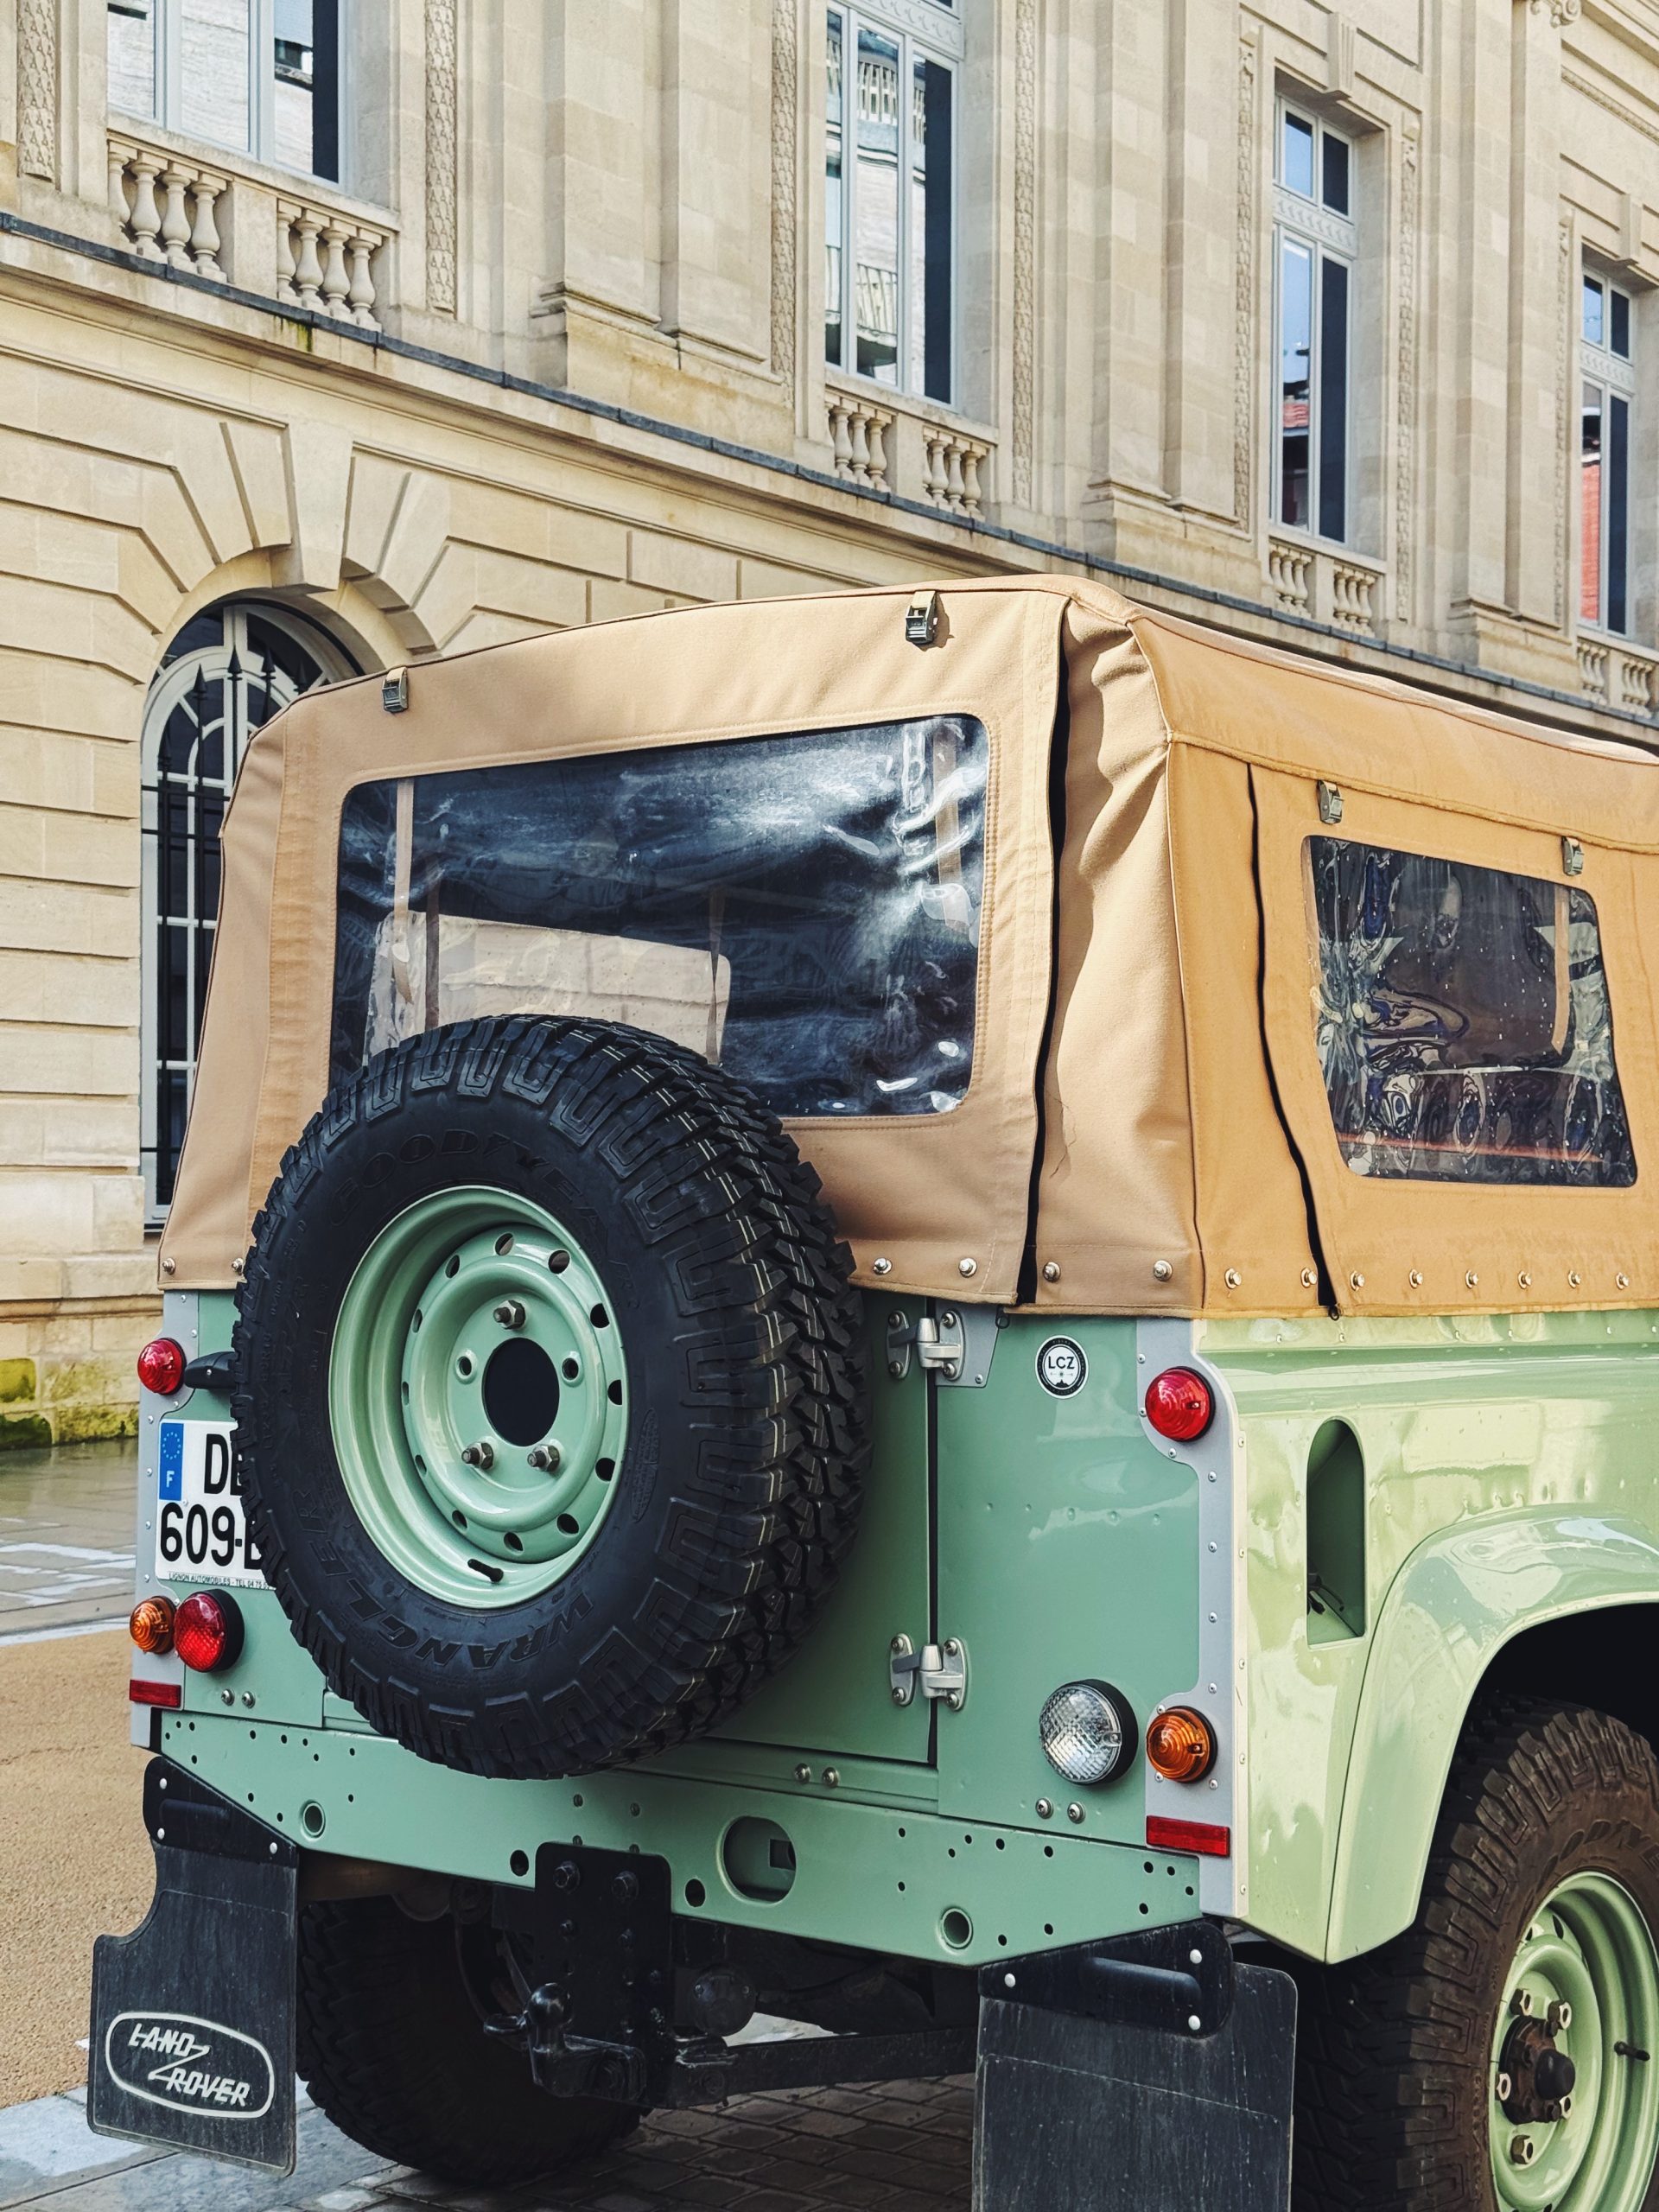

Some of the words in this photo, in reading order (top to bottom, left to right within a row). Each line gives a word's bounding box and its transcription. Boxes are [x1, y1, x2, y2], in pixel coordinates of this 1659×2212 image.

[1048, 1355, 1075, 1370] LCZ
[166, 1471, 175, 1488] F
[190, 1574, 231, 1586] AUTOMOBILES
[235, 1579, 245, 1587] TEL
[292, 1489, 594, 1669] WRANGLER
[128, 2023, 195, 2057] LAND
[165, 2068, 251, 2107] ROVER
